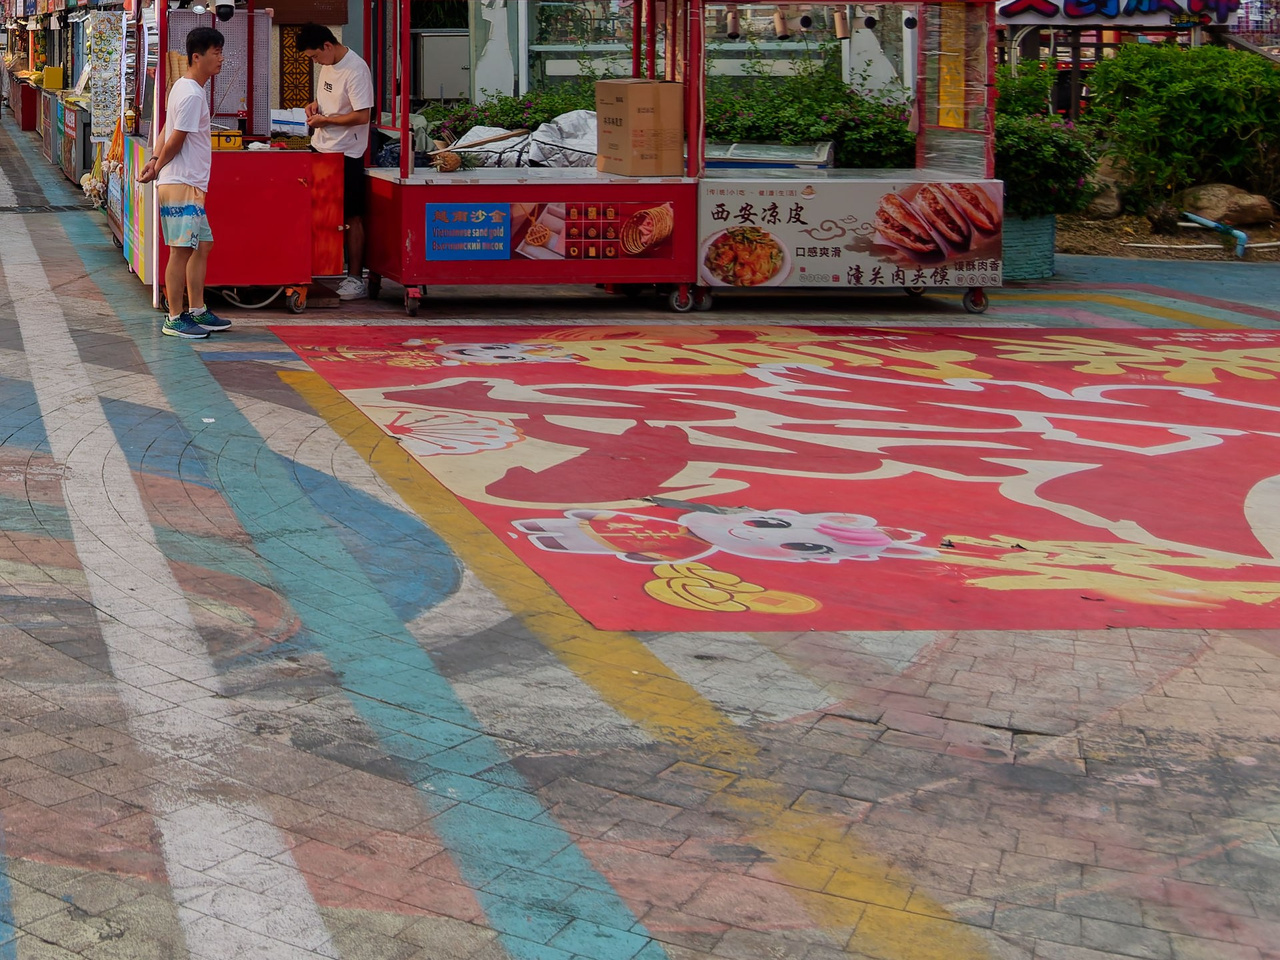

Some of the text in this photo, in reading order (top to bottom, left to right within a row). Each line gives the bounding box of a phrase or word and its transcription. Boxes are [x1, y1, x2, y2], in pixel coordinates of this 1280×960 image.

[711, 202, 808, 225] 西安凉皮
[795, 247, 842, 258] 口感爽滑
[846, 265, 951, 286] 潼关肉夹馍
